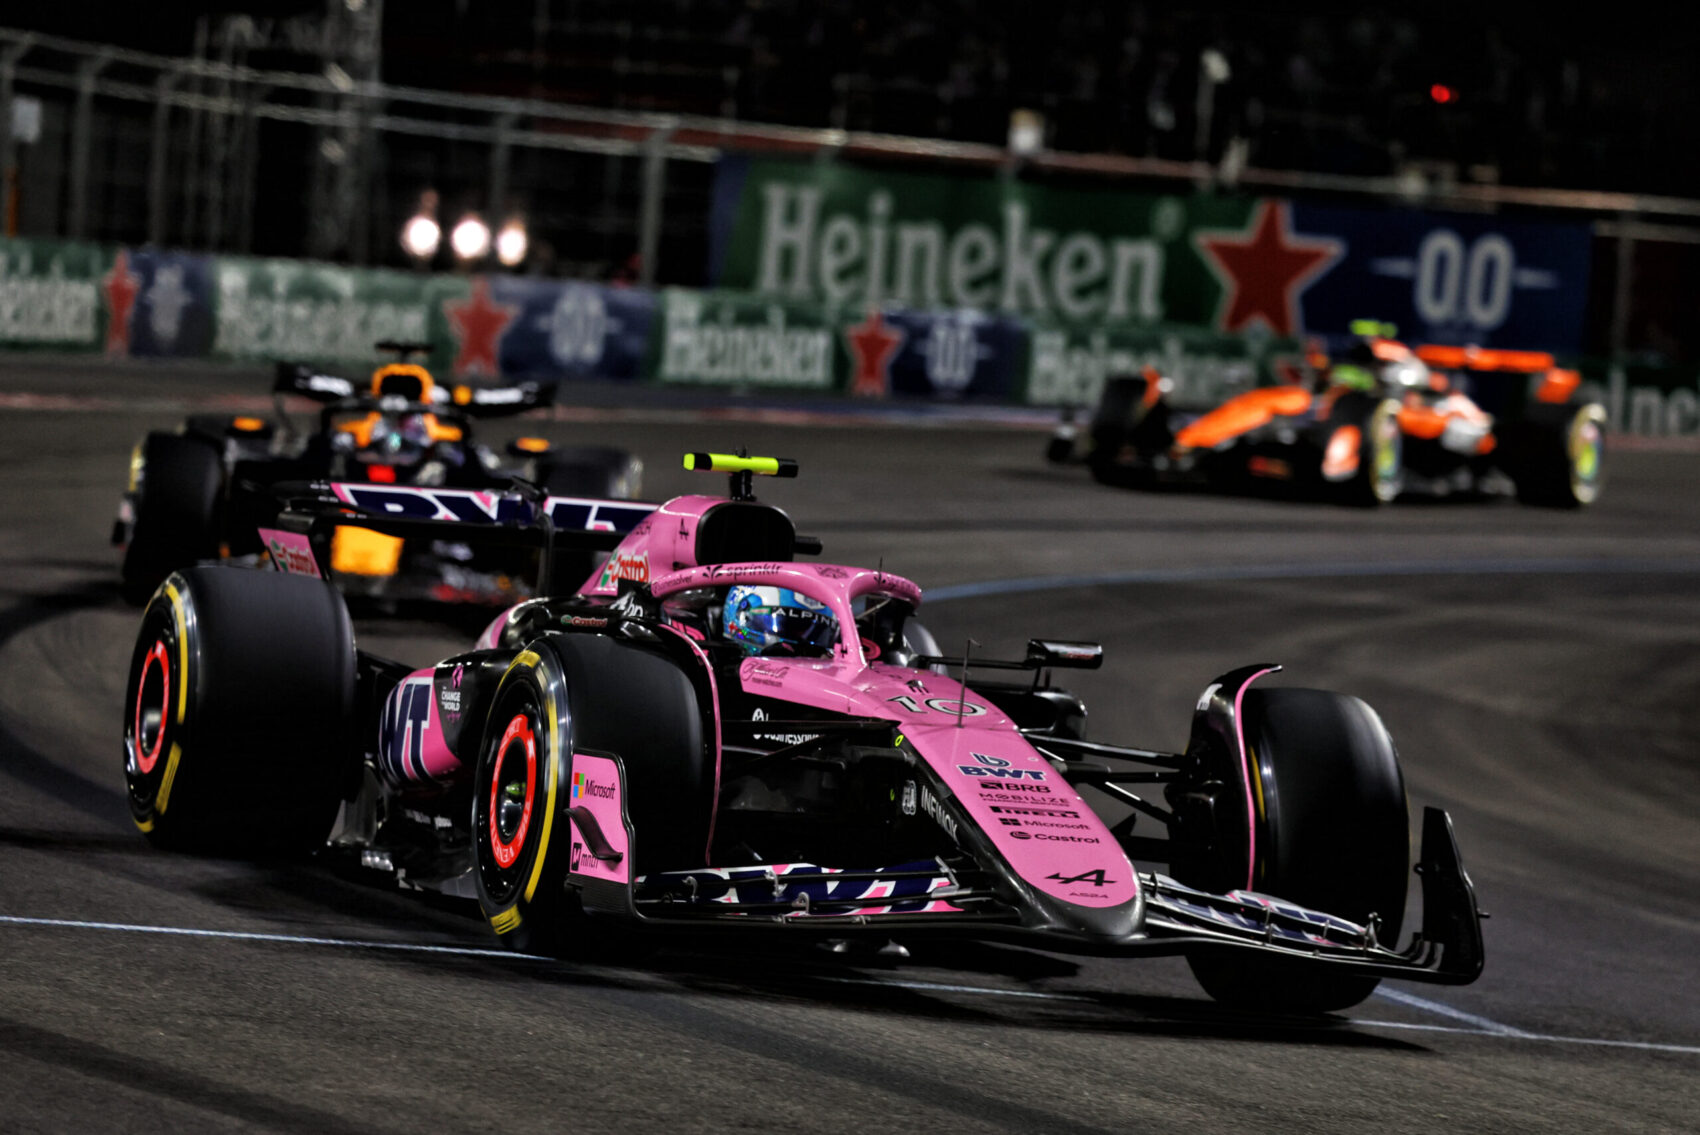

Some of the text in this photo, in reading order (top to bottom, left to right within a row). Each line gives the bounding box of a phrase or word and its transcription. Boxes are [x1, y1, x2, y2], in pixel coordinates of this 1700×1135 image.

[757, 182, 1163, 319] Heineken
[610, 552, 651, 584] Castrol
[726, 563, 782, 581] sprinklr
[887, 696, 988, 717] 10
[956, 764, 1047, 781] BWT
[585, 779, 616, 800] Microsoft
[1005, 783, 1052, 794] BRB
[978, 792, 1070, 804] MOBILIZE
[990, 805, 1081, 819] PIRELLI
[1023, 820, 1092, 830] Microsoft
[1034, 833, 1100, 845] Castrol
